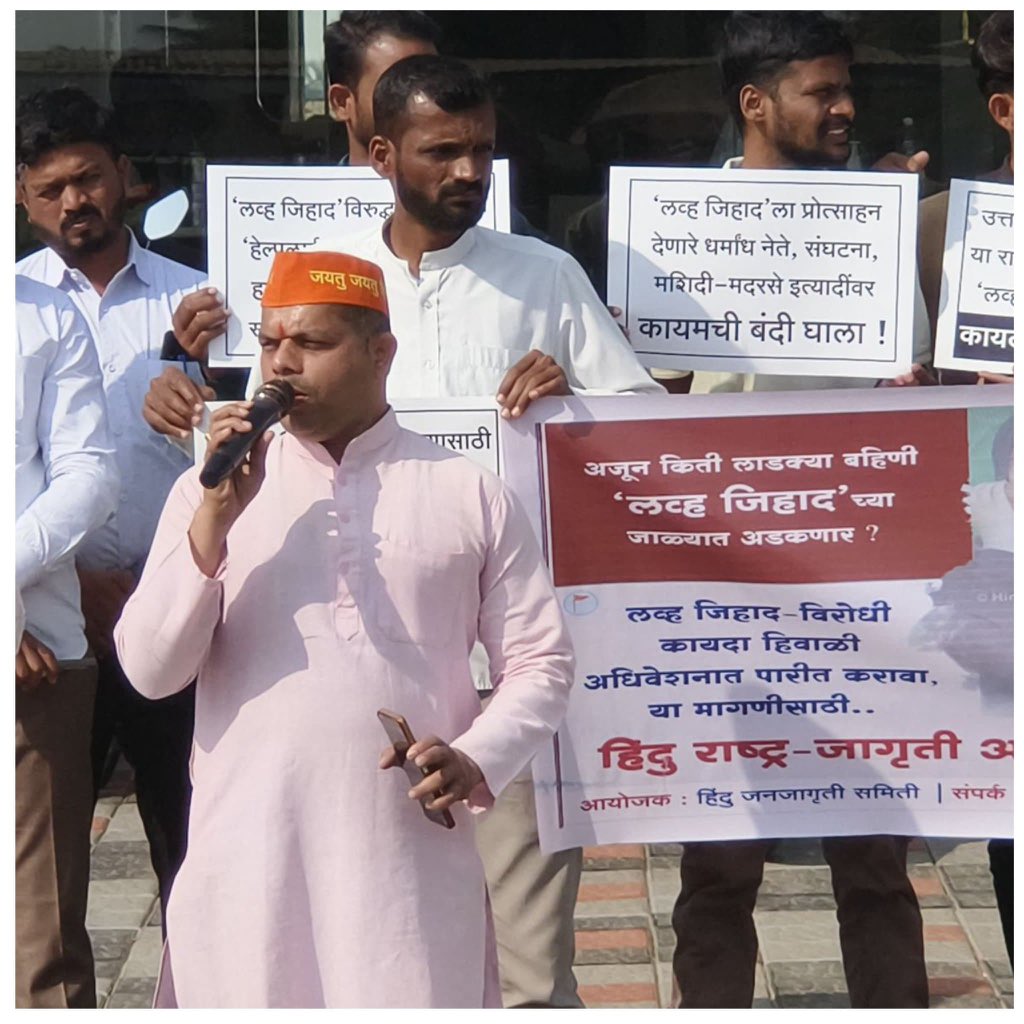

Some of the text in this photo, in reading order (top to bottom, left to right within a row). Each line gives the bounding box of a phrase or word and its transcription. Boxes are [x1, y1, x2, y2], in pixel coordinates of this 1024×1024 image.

[232, 195, 276, 221] ‘लव्ह
[653, 194, 699, 220] ‘लव्ह
[801, 196, 882, 224] प्रोत्साहन
[651, 231, 878, 262] देणारे धर्मांध नेते, संघटना,
[971, 247, 992, 264] या
[309, 270, 379, 297] जयतु जयतु
[789, 274, 875, 299] इत्यादींवर
[637, 311, 886, 346] कायमची बंदी घाला !
[583, 444, 919, 482] अजून किती लाडक्या बहिणी
[612, 490, 708, 518] ‘लव्ह
[626, 524, 879, 548] जाळ्यात अडकणार ?
[625, 605, 685, 625] लव्ह
[658, 631, 861, 655] कायदा हिवाळी
[583, 661, 939, 691] अधिवेशनात पारीत करावा,
[647, 702, 682, 719] या
[597, 736, 678, 776] हिंदु
[579, 792, 672, 813] आयोजक
[697, 788, 735, 808] हिंदु
[742, 783, 844, 805] जनजागृती
[854, 781, 920, 801] समिती
[952, 784, 1007, 801] संपर्क
